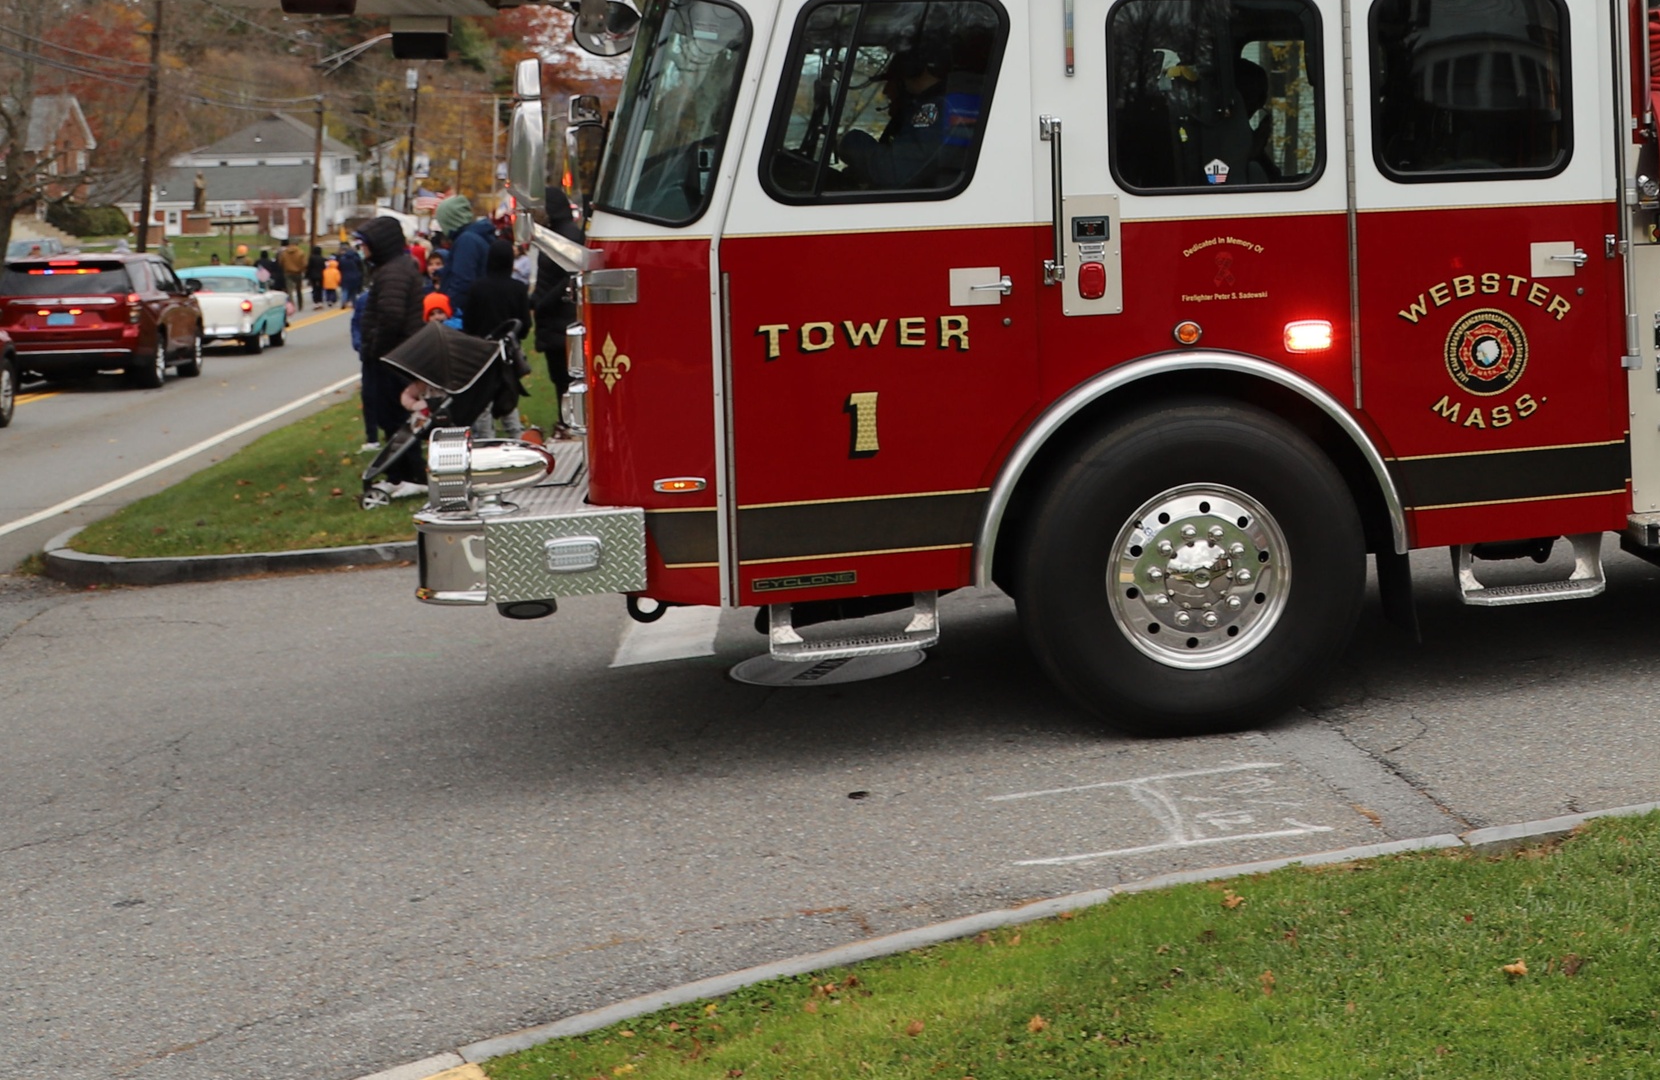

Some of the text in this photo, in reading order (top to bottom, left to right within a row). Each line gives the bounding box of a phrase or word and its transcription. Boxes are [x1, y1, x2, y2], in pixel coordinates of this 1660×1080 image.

[1183, 237, 1217, 257] Dedicated
[1218, 236, 1225, 244] In
[1226, 236, 1254, 250] Memory
[1182, 294, 1213, 303] Firefighter
[1239, 291, 1268, 299] Sadowski
[1398, 272, 1572, 324] WEBSTER
[757, 314, 971, 360] TOWER
[846, 391, 880, 456] 1
[1431, 392, 1548, 429] MASS.
[755, 573, 854, 589] CYCLONE
